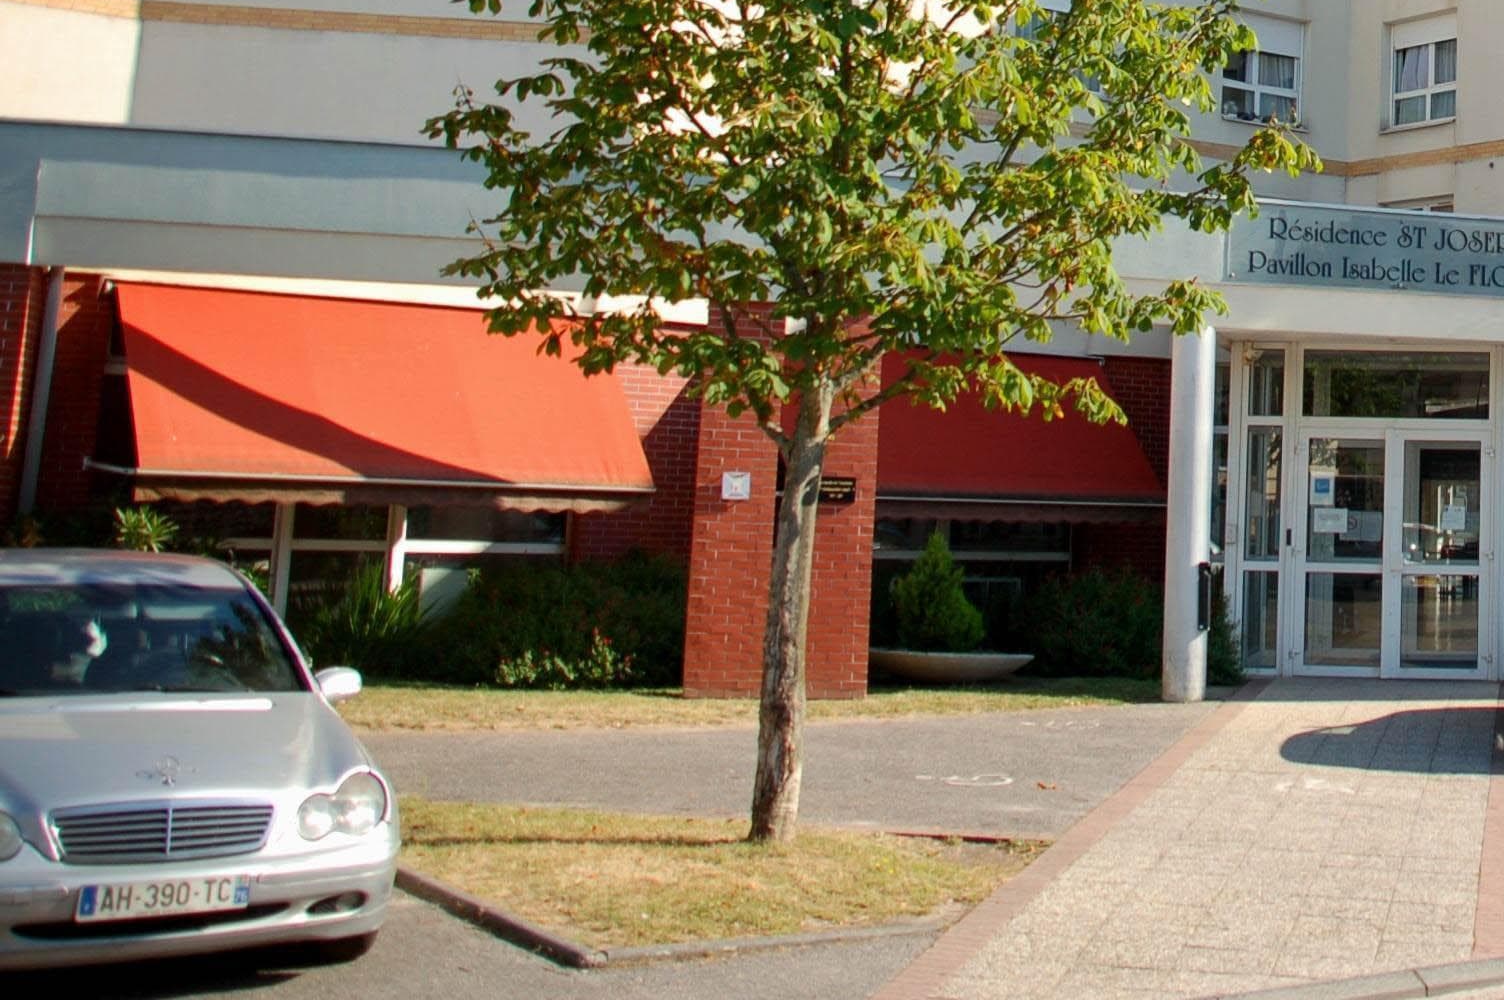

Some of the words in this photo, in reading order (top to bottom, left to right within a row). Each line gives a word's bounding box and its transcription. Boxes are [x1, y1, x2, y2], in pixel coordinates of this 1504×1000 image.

[1268, 217, 1387, 247] Résidence
[1396, 225, 1427, 249] ST
[1247, 250, 1332, 278] Pavillon
[1342, 256, 1426, 283] Isabelle
[1434, 262, 1460, 286] Le
